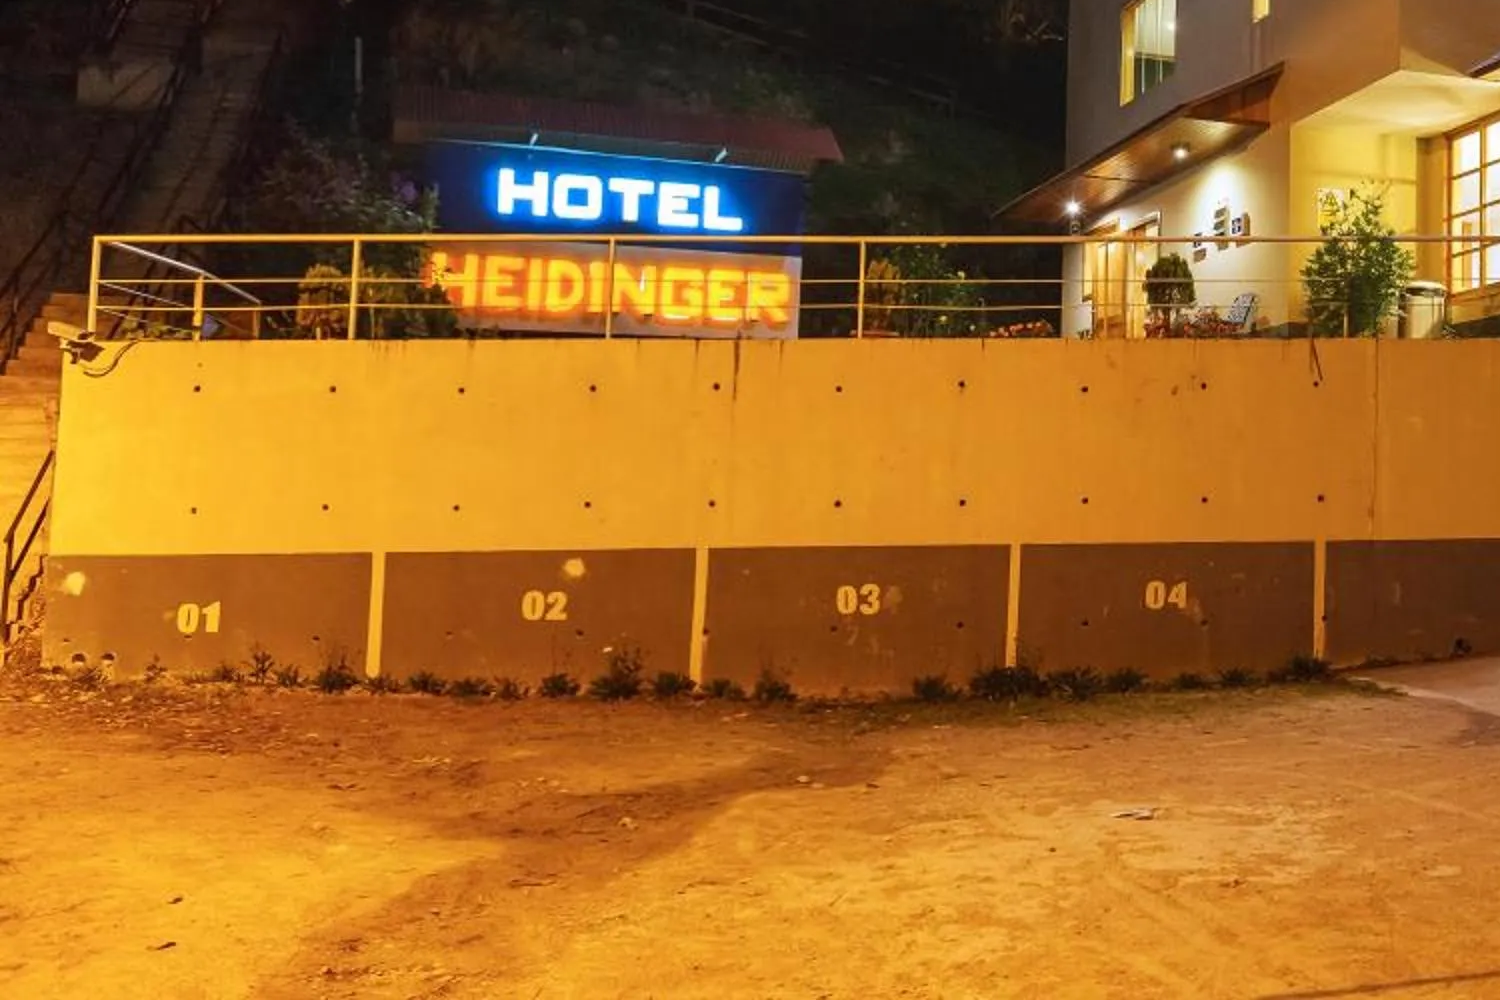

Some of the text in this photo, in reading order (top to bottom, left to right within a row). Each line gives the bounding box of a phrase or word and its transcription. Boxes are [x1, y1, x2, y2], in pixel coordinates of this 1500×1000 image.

[497, 167, 744, 232] HOTEL
[427, 252, 791, 323] HEIDINGER
[521, 590, 568, 621] 02
[836, 584, 881, 615] 03
[1145, 580, 1188, 609] 04
[177, 601, 221, 633] 01
